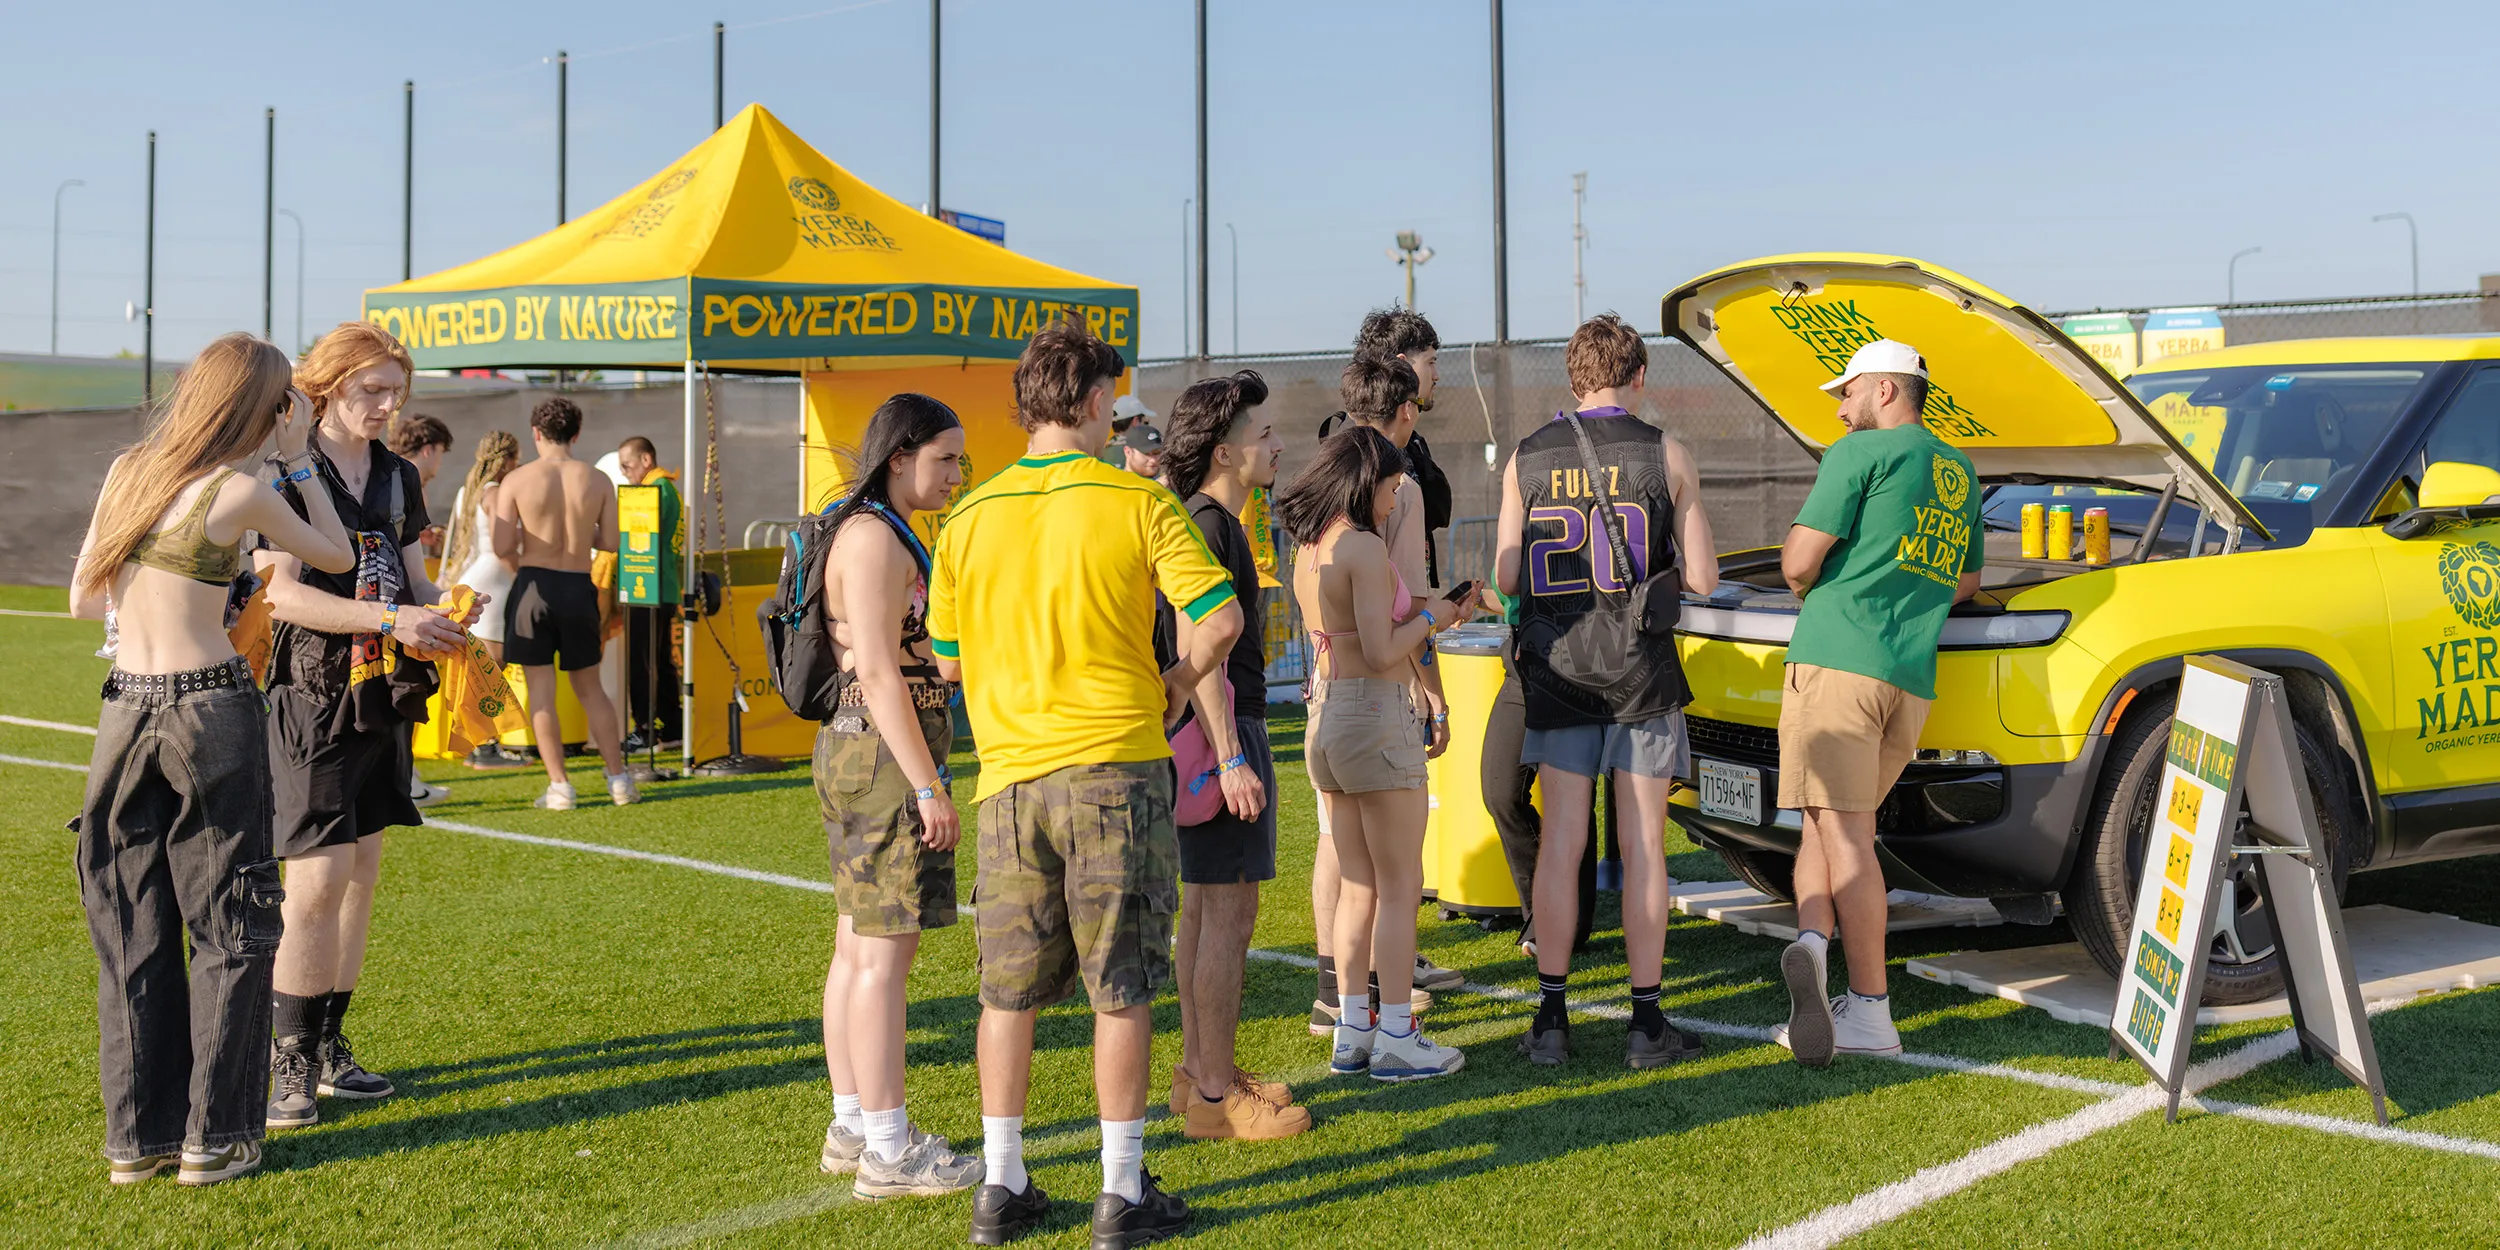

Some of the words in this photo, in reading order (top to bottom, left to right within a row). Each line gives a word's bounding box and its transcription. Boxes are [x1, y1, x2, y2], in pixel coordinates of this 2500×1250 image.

[790, 213, 883, 235] YERBA
[801, 230, 903, 251] MADRE
[514, 296, 551, 341] BY
[559, 295, 677, 341] NATURE
[703, 291, 918, 337] POWERED
[931, 291, 979, 336] BY
[1769, 299, 1875, 330] DRINK
[2157, 338, 2210, 356] YERBA
[1551, 465, 1620, 500] FULZ
[1913, 505, 1970, 554] YERBA
[1529, 502, 1650, 597] 20
[2443, 626, 2458, 637] EST.
[2171, 730, 2199, 763] YERB
[2201, 745, 2234, 780] TIME
[2425, 735, 2475, 753] ORGANIC
[1714, 767, 1728, 775] NEW
[1728, 768, 1745, 780] YORK
[1703, 775, 1735, 806] 71596
[1742, 782, 1755, 810] NF
[2138, 943, 2167, 984] COME
[2131, 1000, 2163, 1045] LIFE
